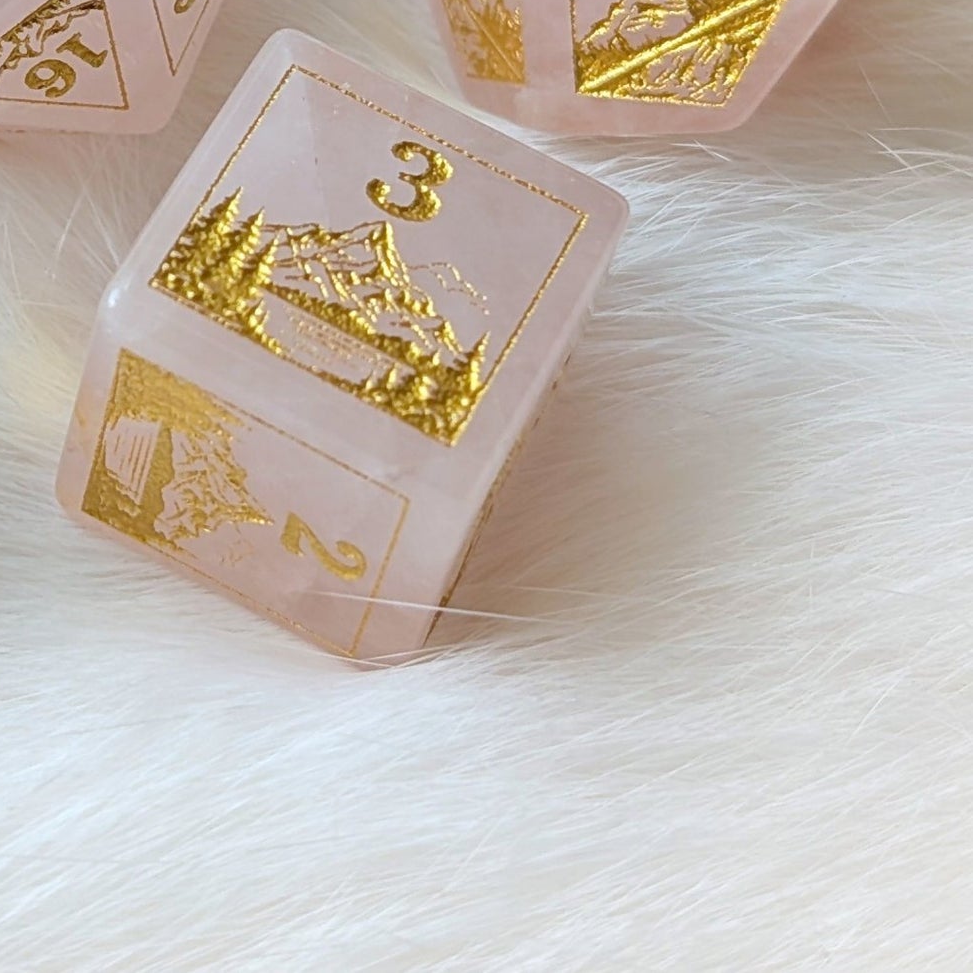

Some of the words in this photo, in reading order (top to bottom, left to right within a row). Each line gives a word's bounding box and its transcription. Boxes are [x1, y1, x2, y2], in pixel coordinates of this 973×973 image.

[25, 31, 108, 99] 16
[365, 140, 454, 222] 3
[280, 512, 368, 582] 2
